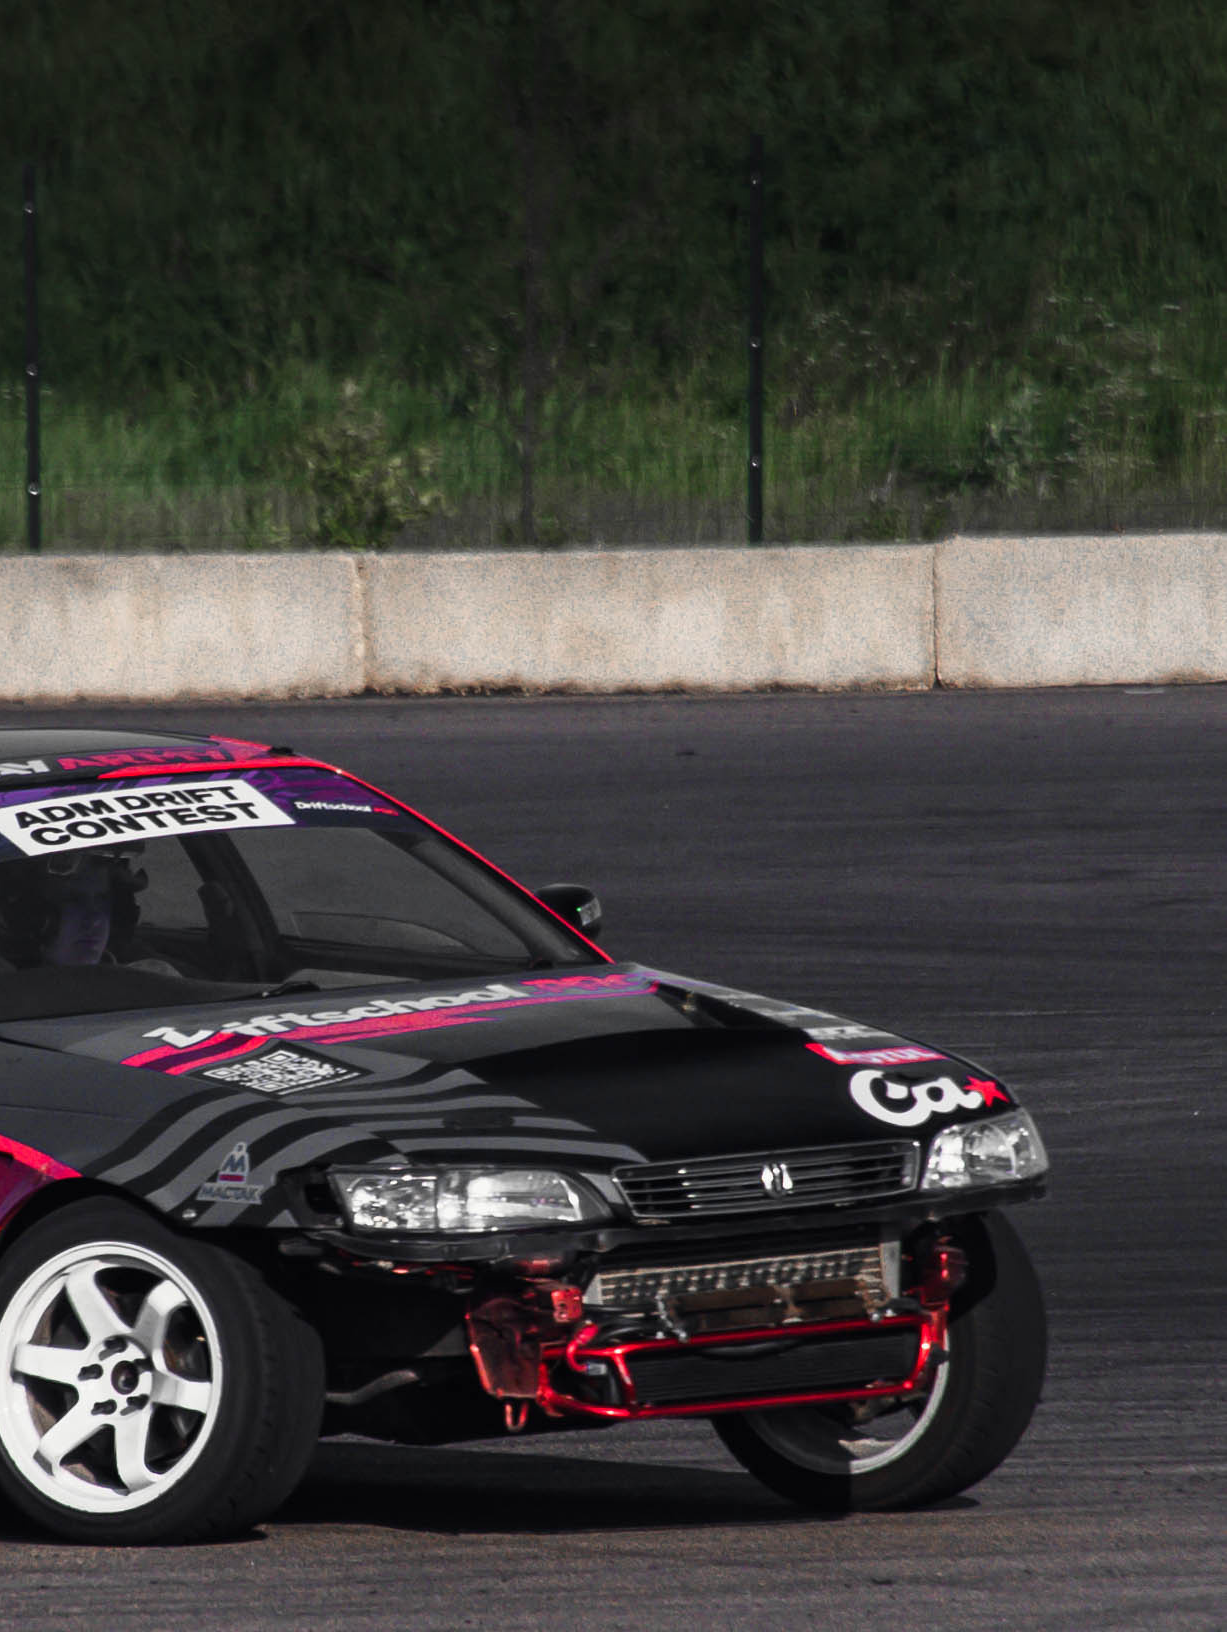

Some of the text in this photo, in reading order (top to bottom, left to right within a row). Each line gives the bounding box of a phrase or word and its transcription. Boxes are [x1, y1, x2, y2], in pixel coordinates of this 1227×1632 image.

[14, 785, 235, 829] ADM DRIFT
[29, 802, 264, 847] CONTEST
